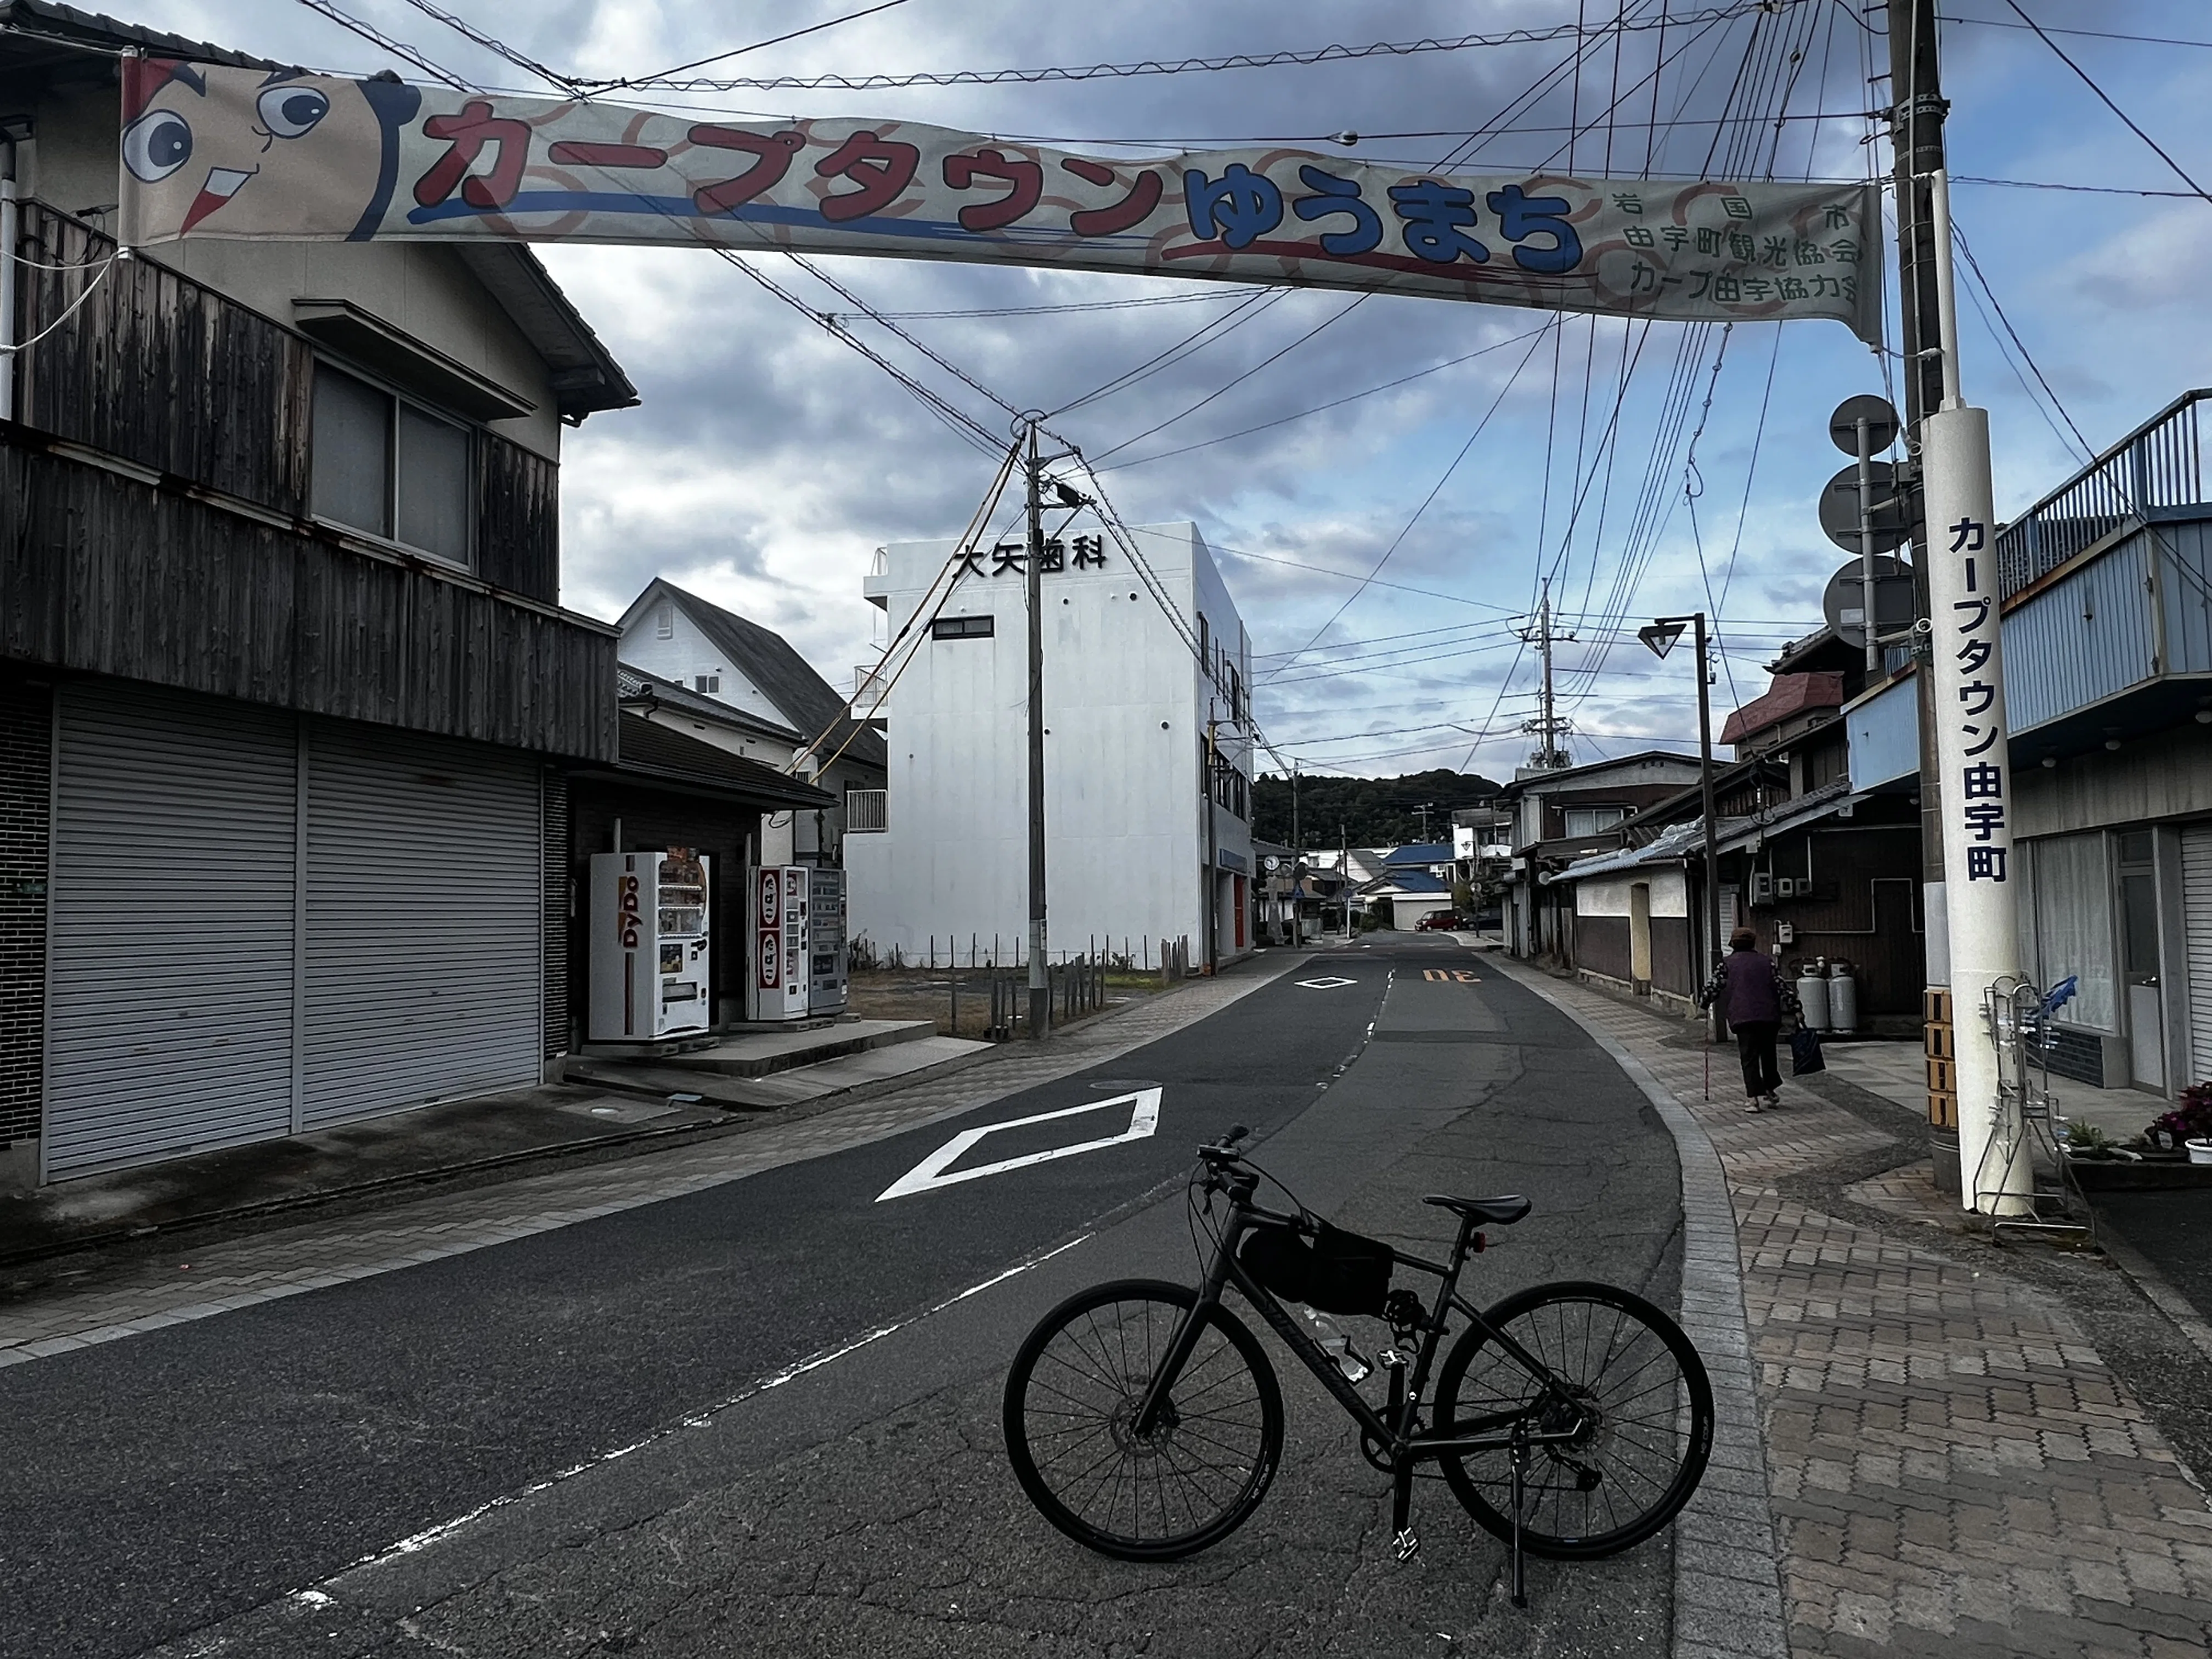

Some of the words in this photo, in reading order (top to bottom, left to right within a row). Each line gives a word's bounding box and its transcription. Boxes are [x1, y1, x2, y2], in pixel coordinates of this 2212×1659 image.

[1623, 225, 1863, 267] 由宇町観光協会
[952, 534, 1107, 578] 大矢歯科
[1949, 517, 2007, 882] カープタウン由宇町
[623, 876, 644, 948] DyDo
